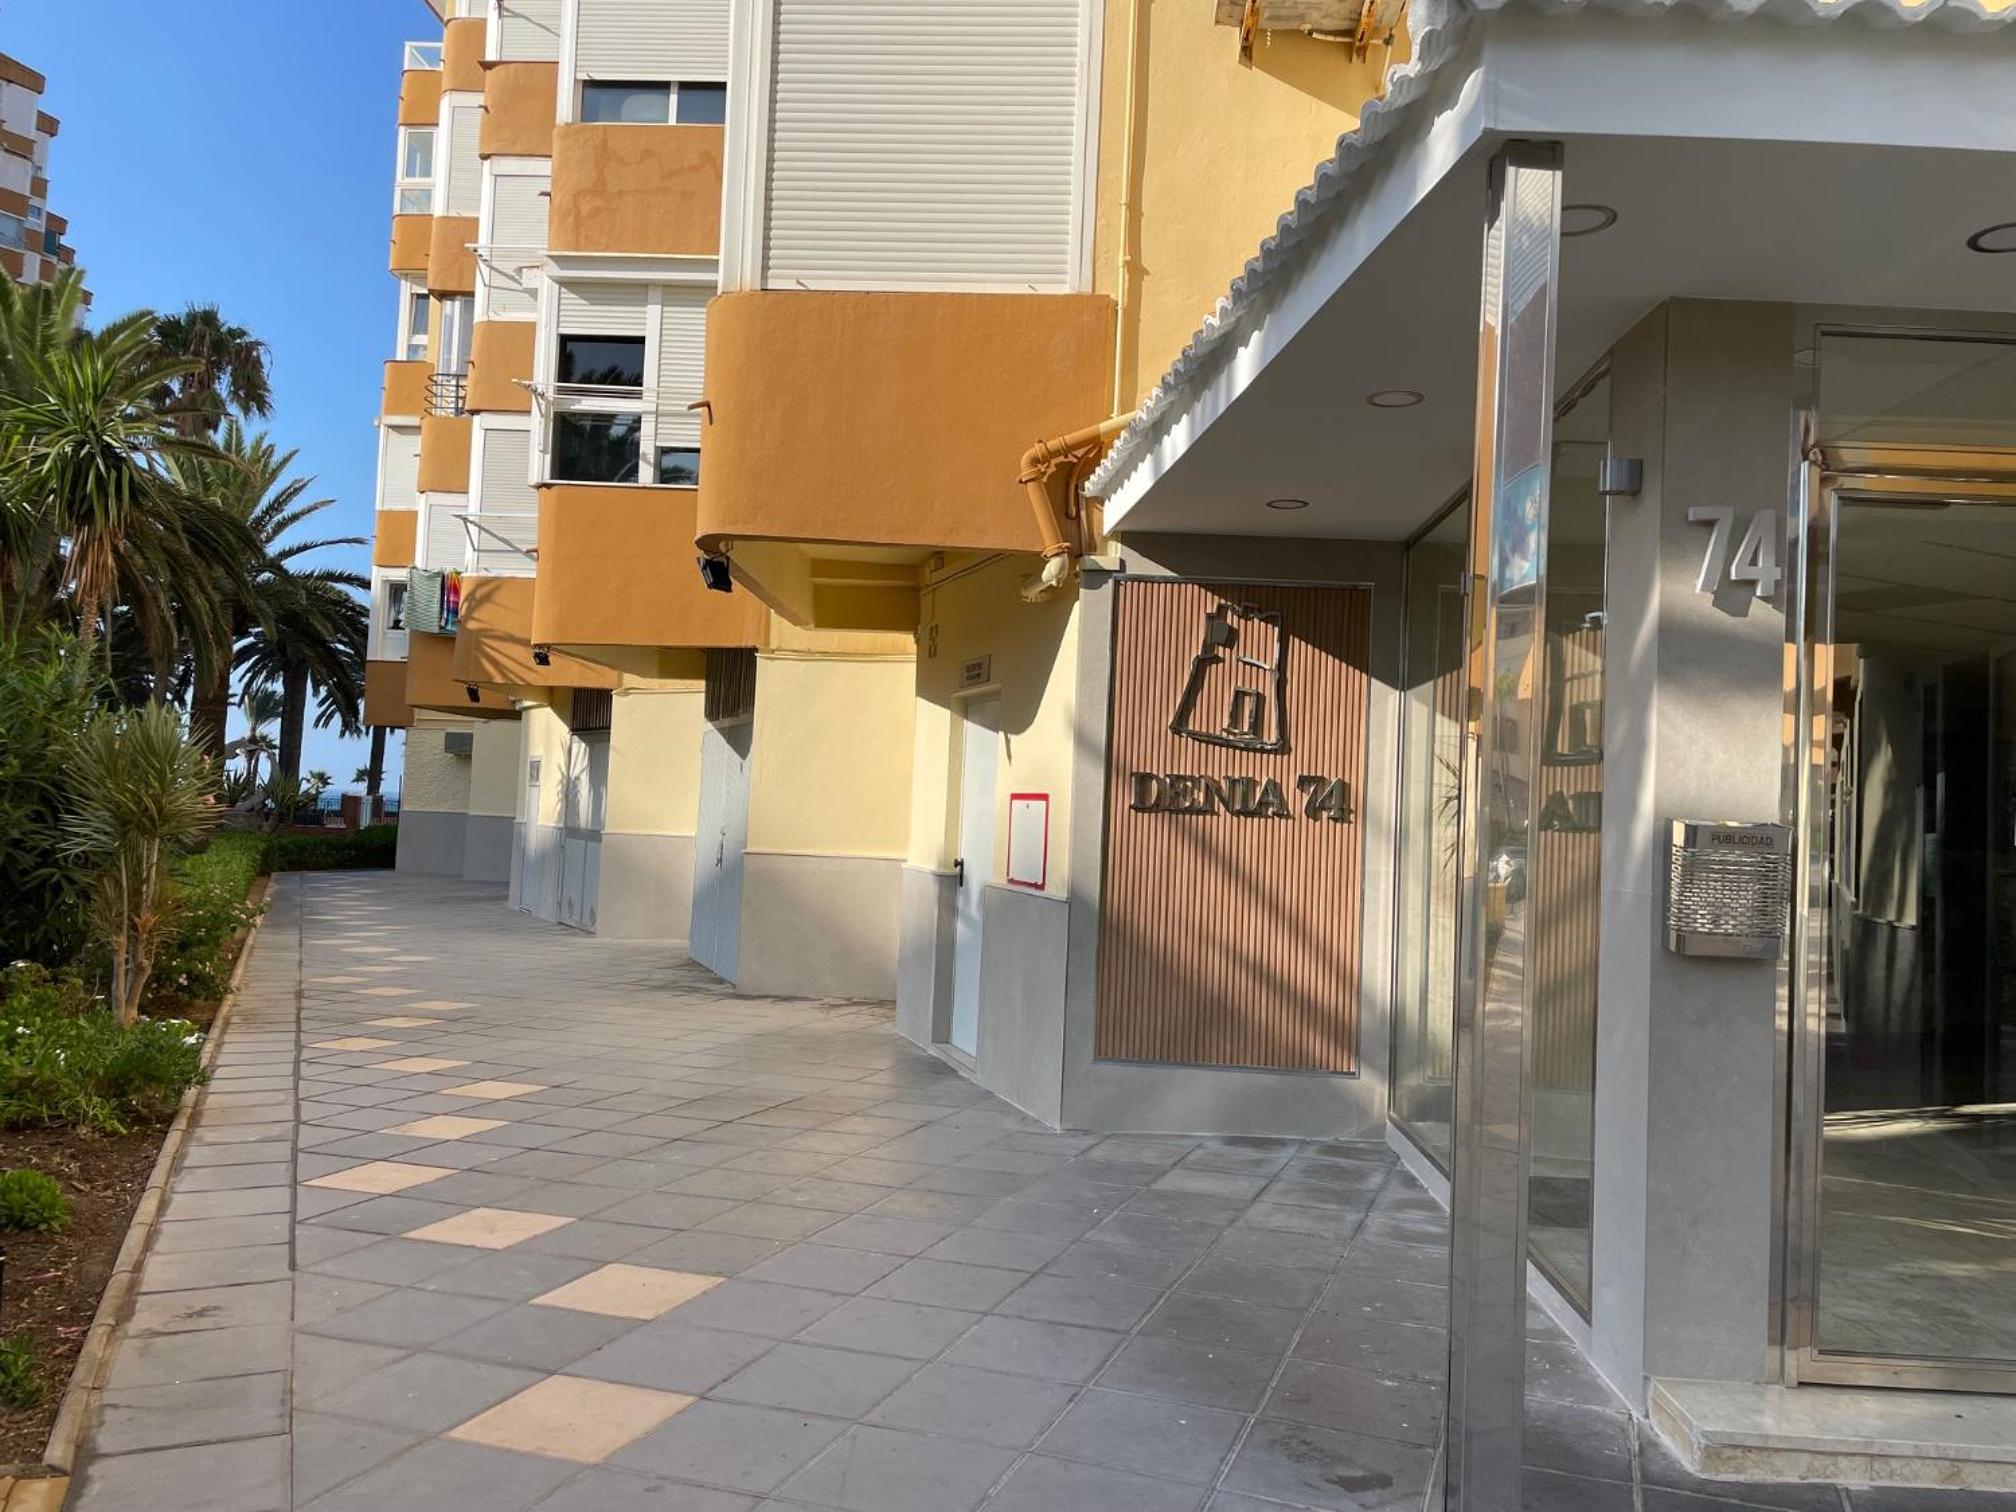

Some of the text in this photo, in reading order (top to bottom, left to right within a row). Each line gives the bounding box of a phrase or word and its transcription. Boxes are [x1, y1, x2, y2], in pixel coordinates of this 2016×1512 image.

[1688, 506, 1781, 596] 74
[1130, 771, 1354, 824] DENIA 74
[1711, 832, 1773, 846] PUBLICIDAD
